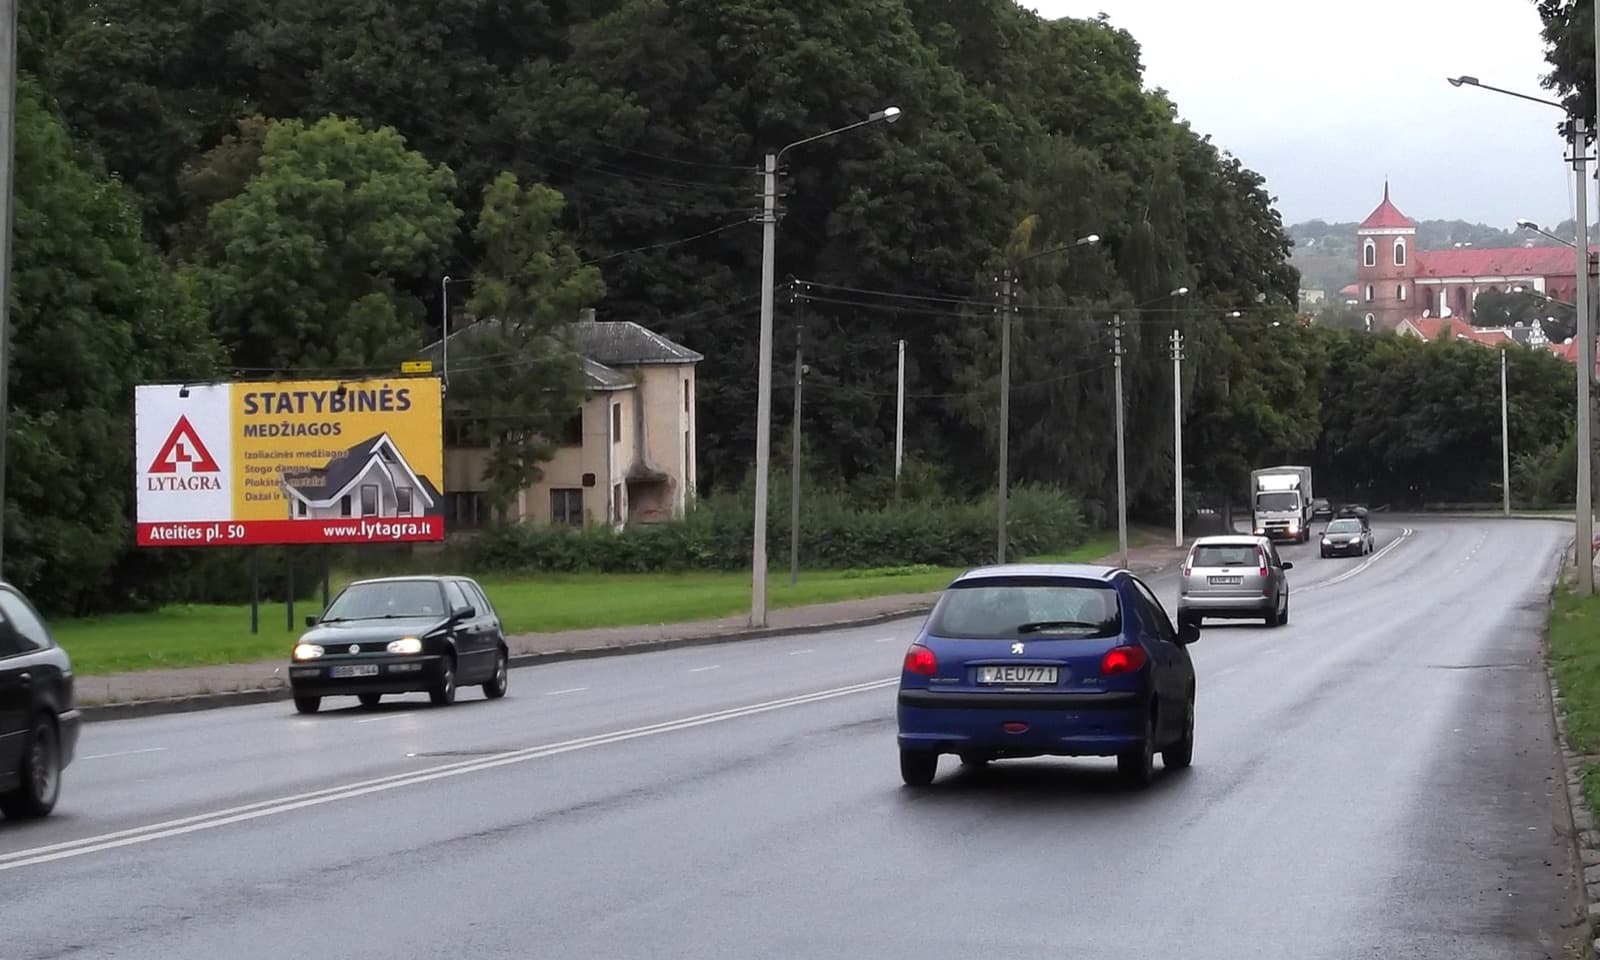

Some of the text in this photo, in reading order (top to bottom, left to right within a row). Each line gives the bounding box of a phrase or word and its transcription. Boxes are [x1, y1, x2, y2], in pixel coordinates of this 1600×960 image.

[244, 384, 411, 415] STATYBINĖS
[244, 421, 342, 437] MEDŽIAGOS
[244, 450, 294, 460] Izoliacinės
[245, 464, 273, 474] Stogo
[147, 475, 222, 492] LYTAGRA
[150, 523, 245, 542] Ateities pl. 50
[323, 520, 431, 539] www.lytagra.lt
[994, 668, 1053, 681] AEU771
